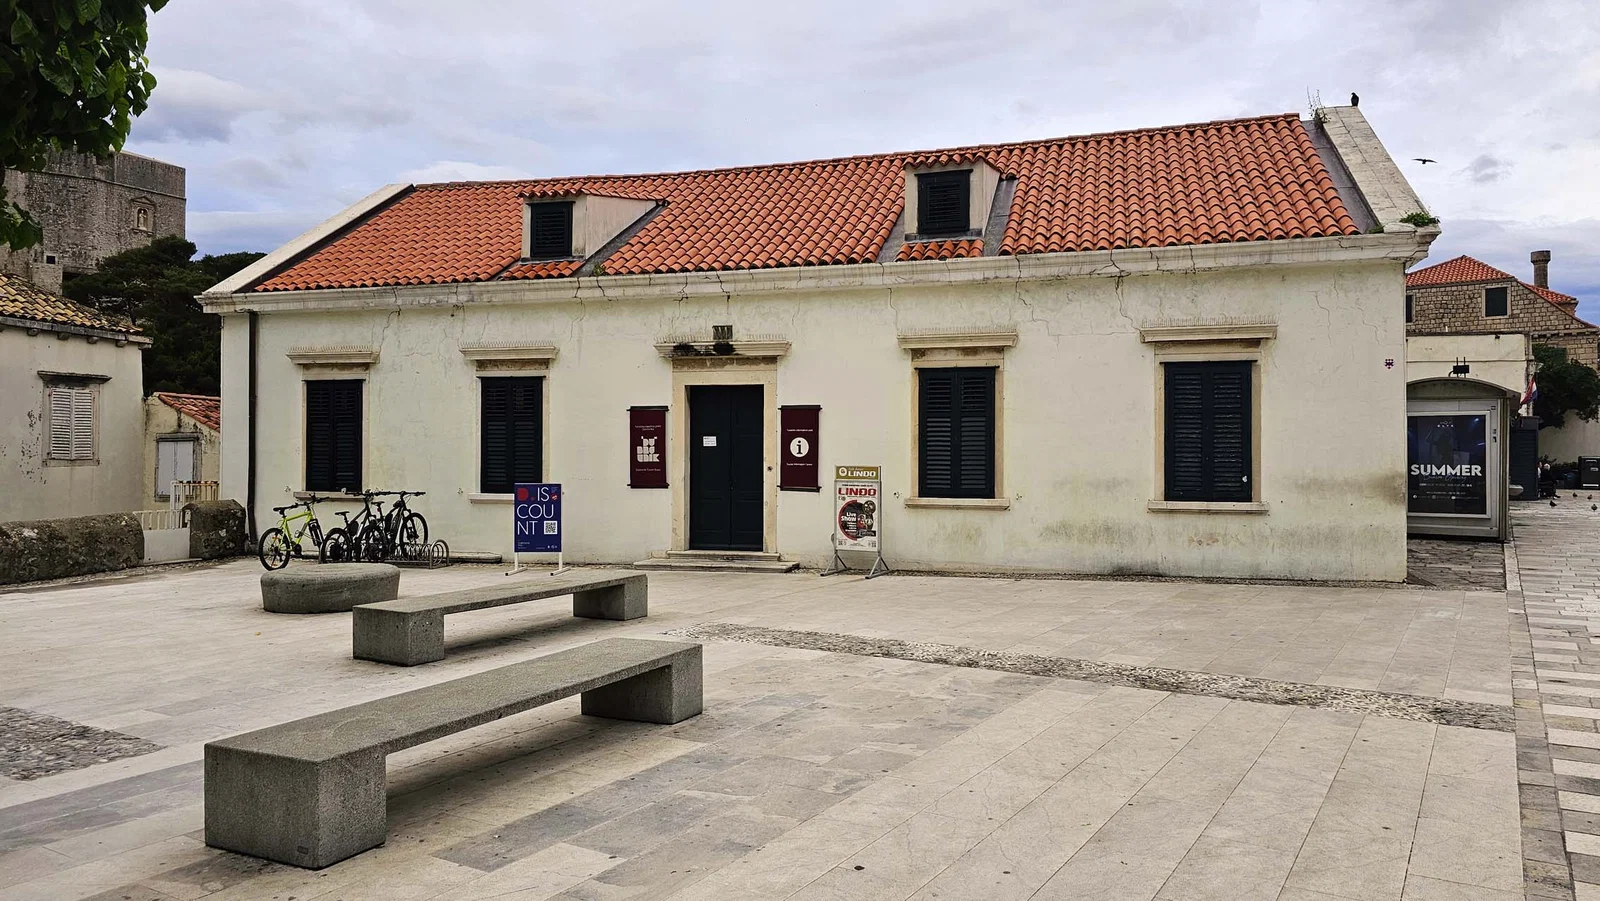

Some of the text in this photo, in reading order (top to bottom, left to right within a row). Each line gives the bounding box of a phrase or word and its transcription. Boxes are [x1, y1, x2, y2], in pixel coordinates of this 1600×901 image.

[1411, 464, 1482, 476] SUMMER
[516, 504, 554, 519] COU
[517, 521, 538, 535] NT
